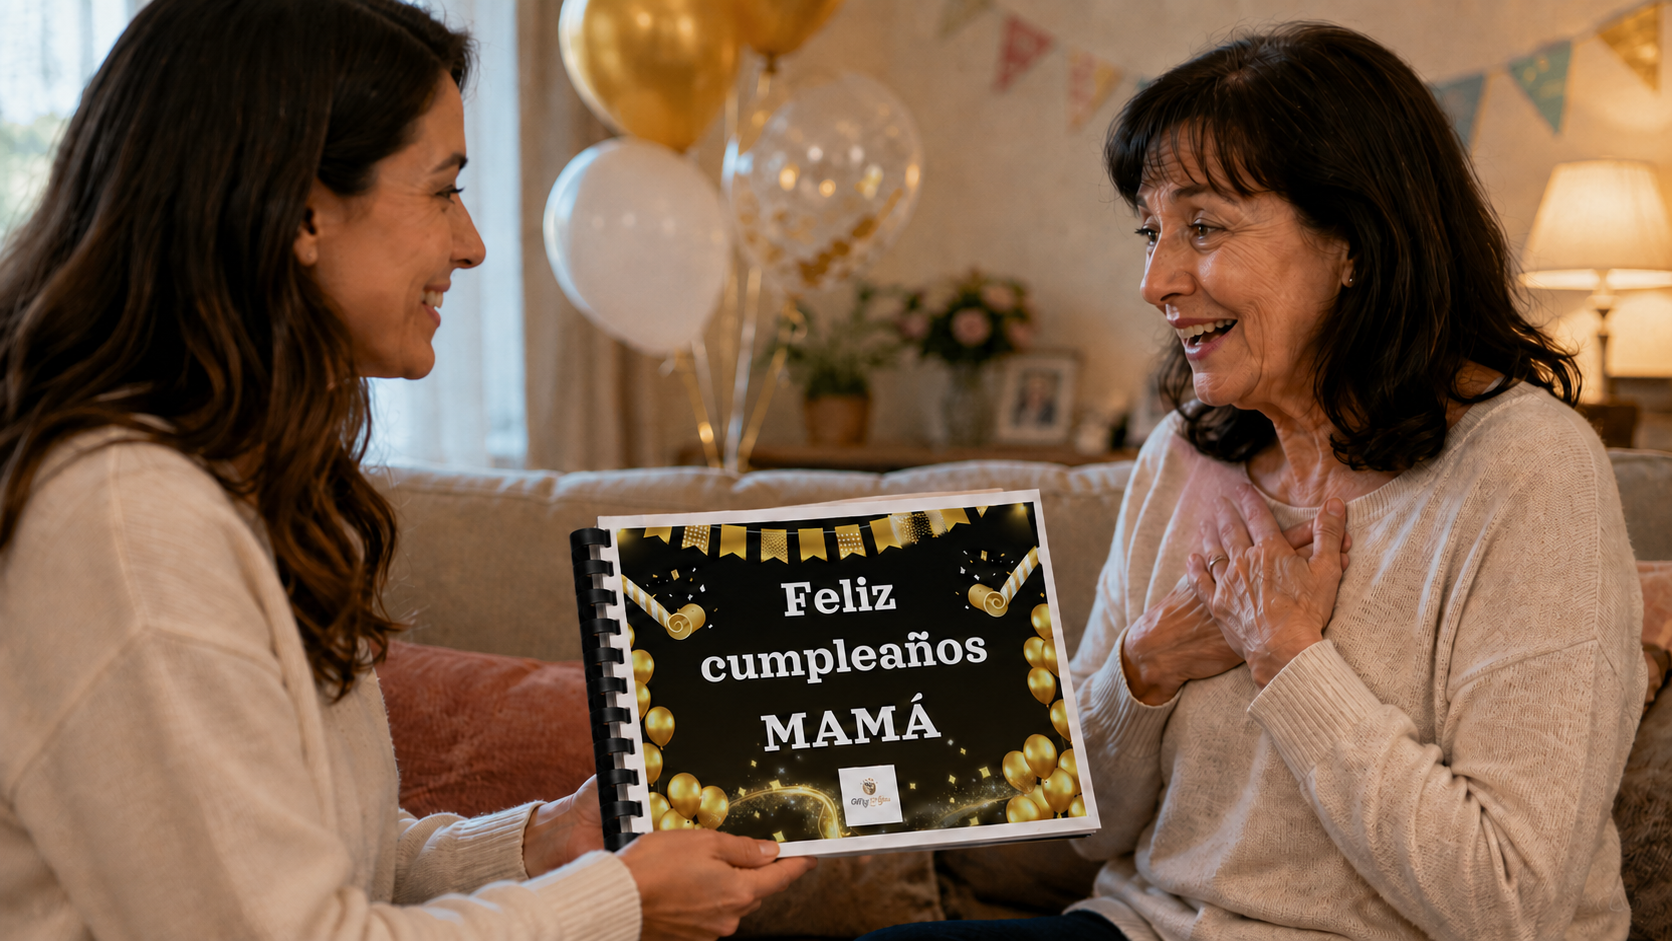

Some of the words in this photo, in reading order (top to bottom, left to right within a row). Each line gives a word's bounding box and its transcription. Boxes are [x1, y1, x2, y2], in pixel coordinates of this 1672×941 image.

[780, 576, 897, 617] Feliz
[700, 630, 988, 684] cumpleaños
[760, 692, 942, 752] MAMÁ
